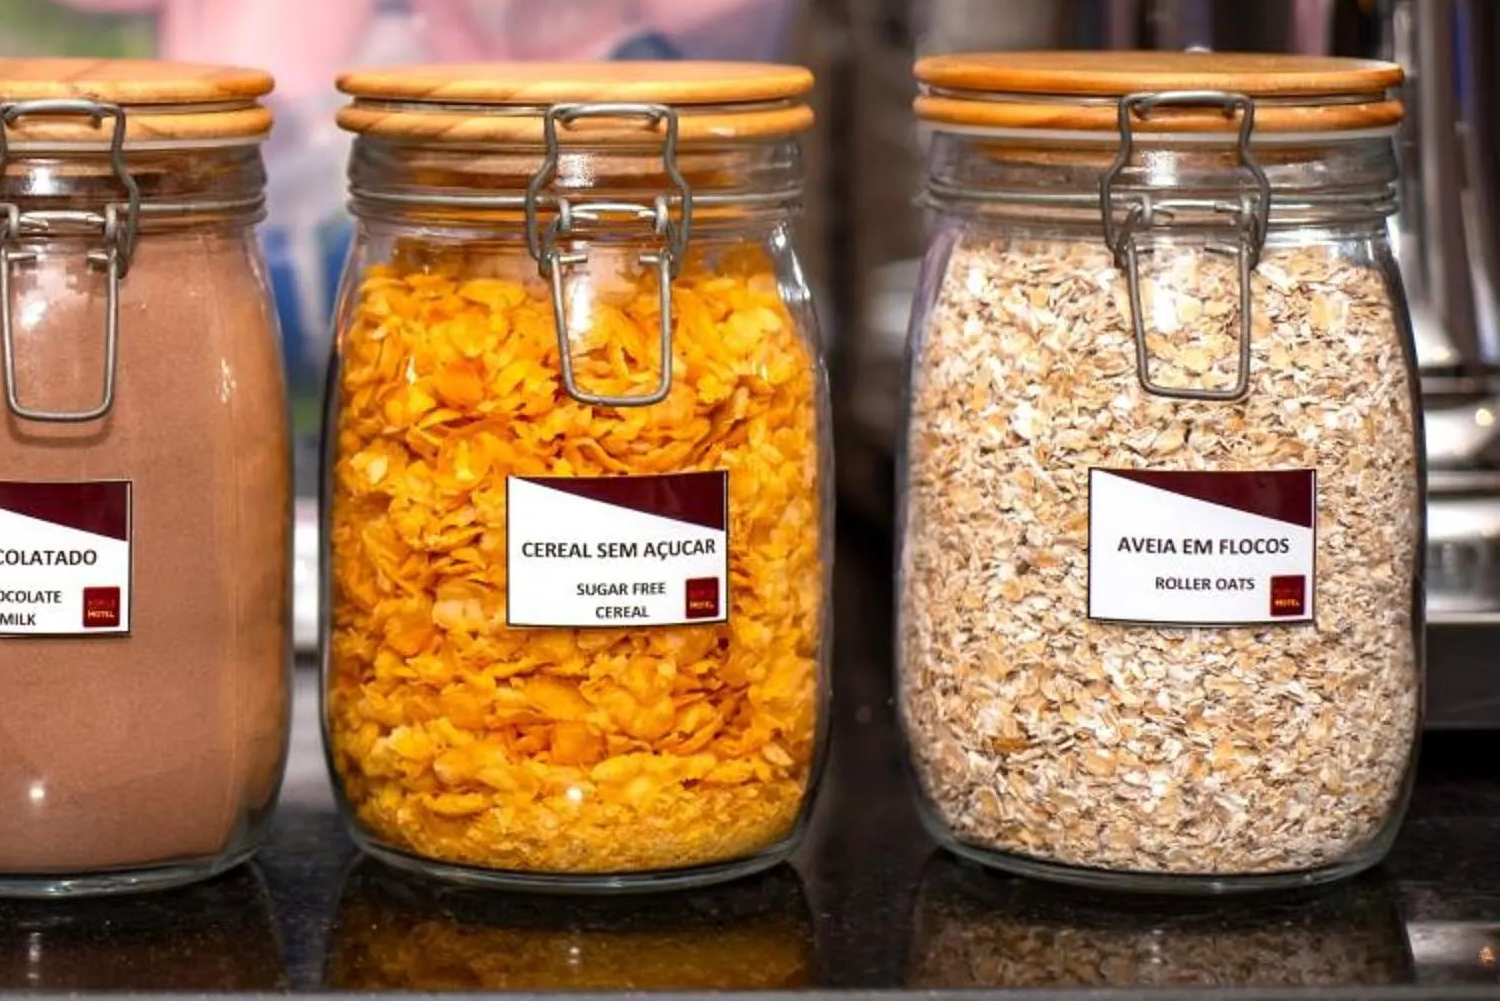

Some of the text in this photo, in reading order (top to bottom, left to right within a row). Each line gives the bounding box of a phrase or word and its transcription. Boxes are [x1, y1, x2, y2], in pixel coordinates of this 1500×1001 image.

[522, 539, 715, 560] CEREAL SEM AÇUCAR
[1118, 537, 1289, 554] AVEIA EM FLOCOS
[577, 583, 665, 595] SUGAR FREE
[1156, 577, 1255, 590] ROLLER OATS
[596, 606, 648, 618] CEREAL
[0, 613, 36, 625] MILK
